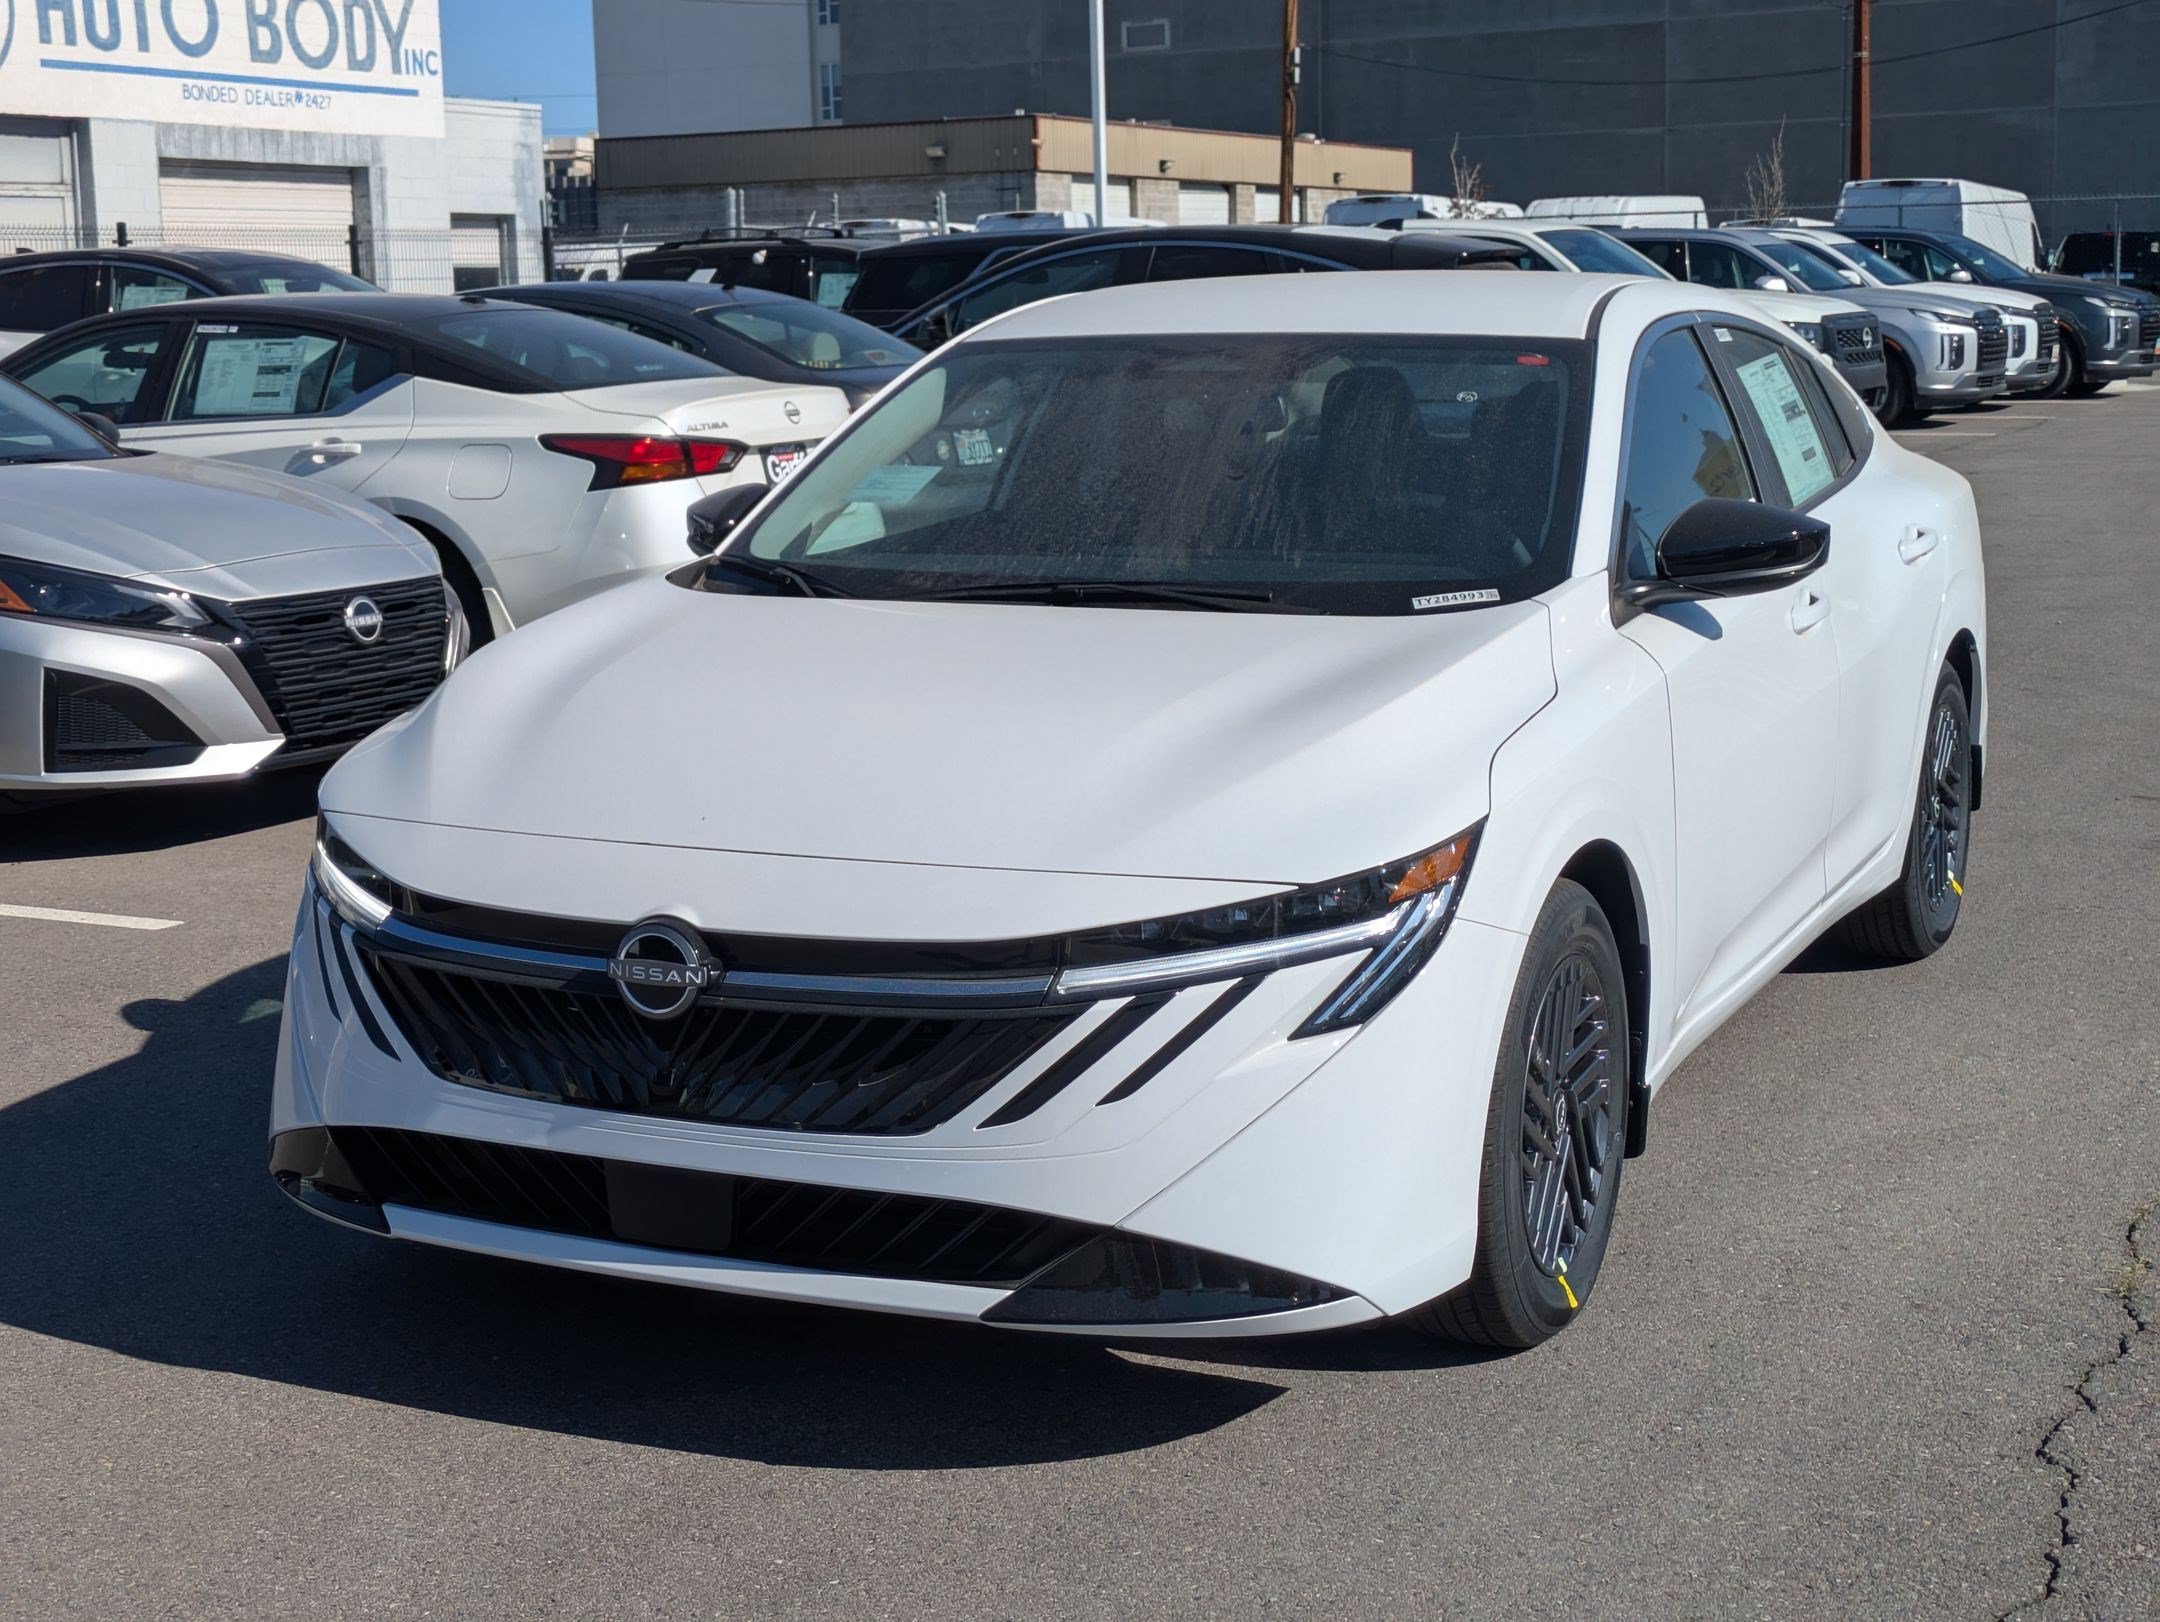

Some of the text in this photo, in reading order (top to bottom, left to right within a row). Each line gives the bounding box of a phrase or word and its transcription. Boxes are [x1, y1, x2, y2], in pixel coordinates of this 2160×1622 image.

[246, 0, 414, 75] BODY
[404, 48, 439, 76] INC
[182, 83, 239, 104] BONDED
[686, 421, 729, 432] ALTIMA
[345, 613, 384, 627] NISSAN
[609, 962, 703, 984] NISSAN
